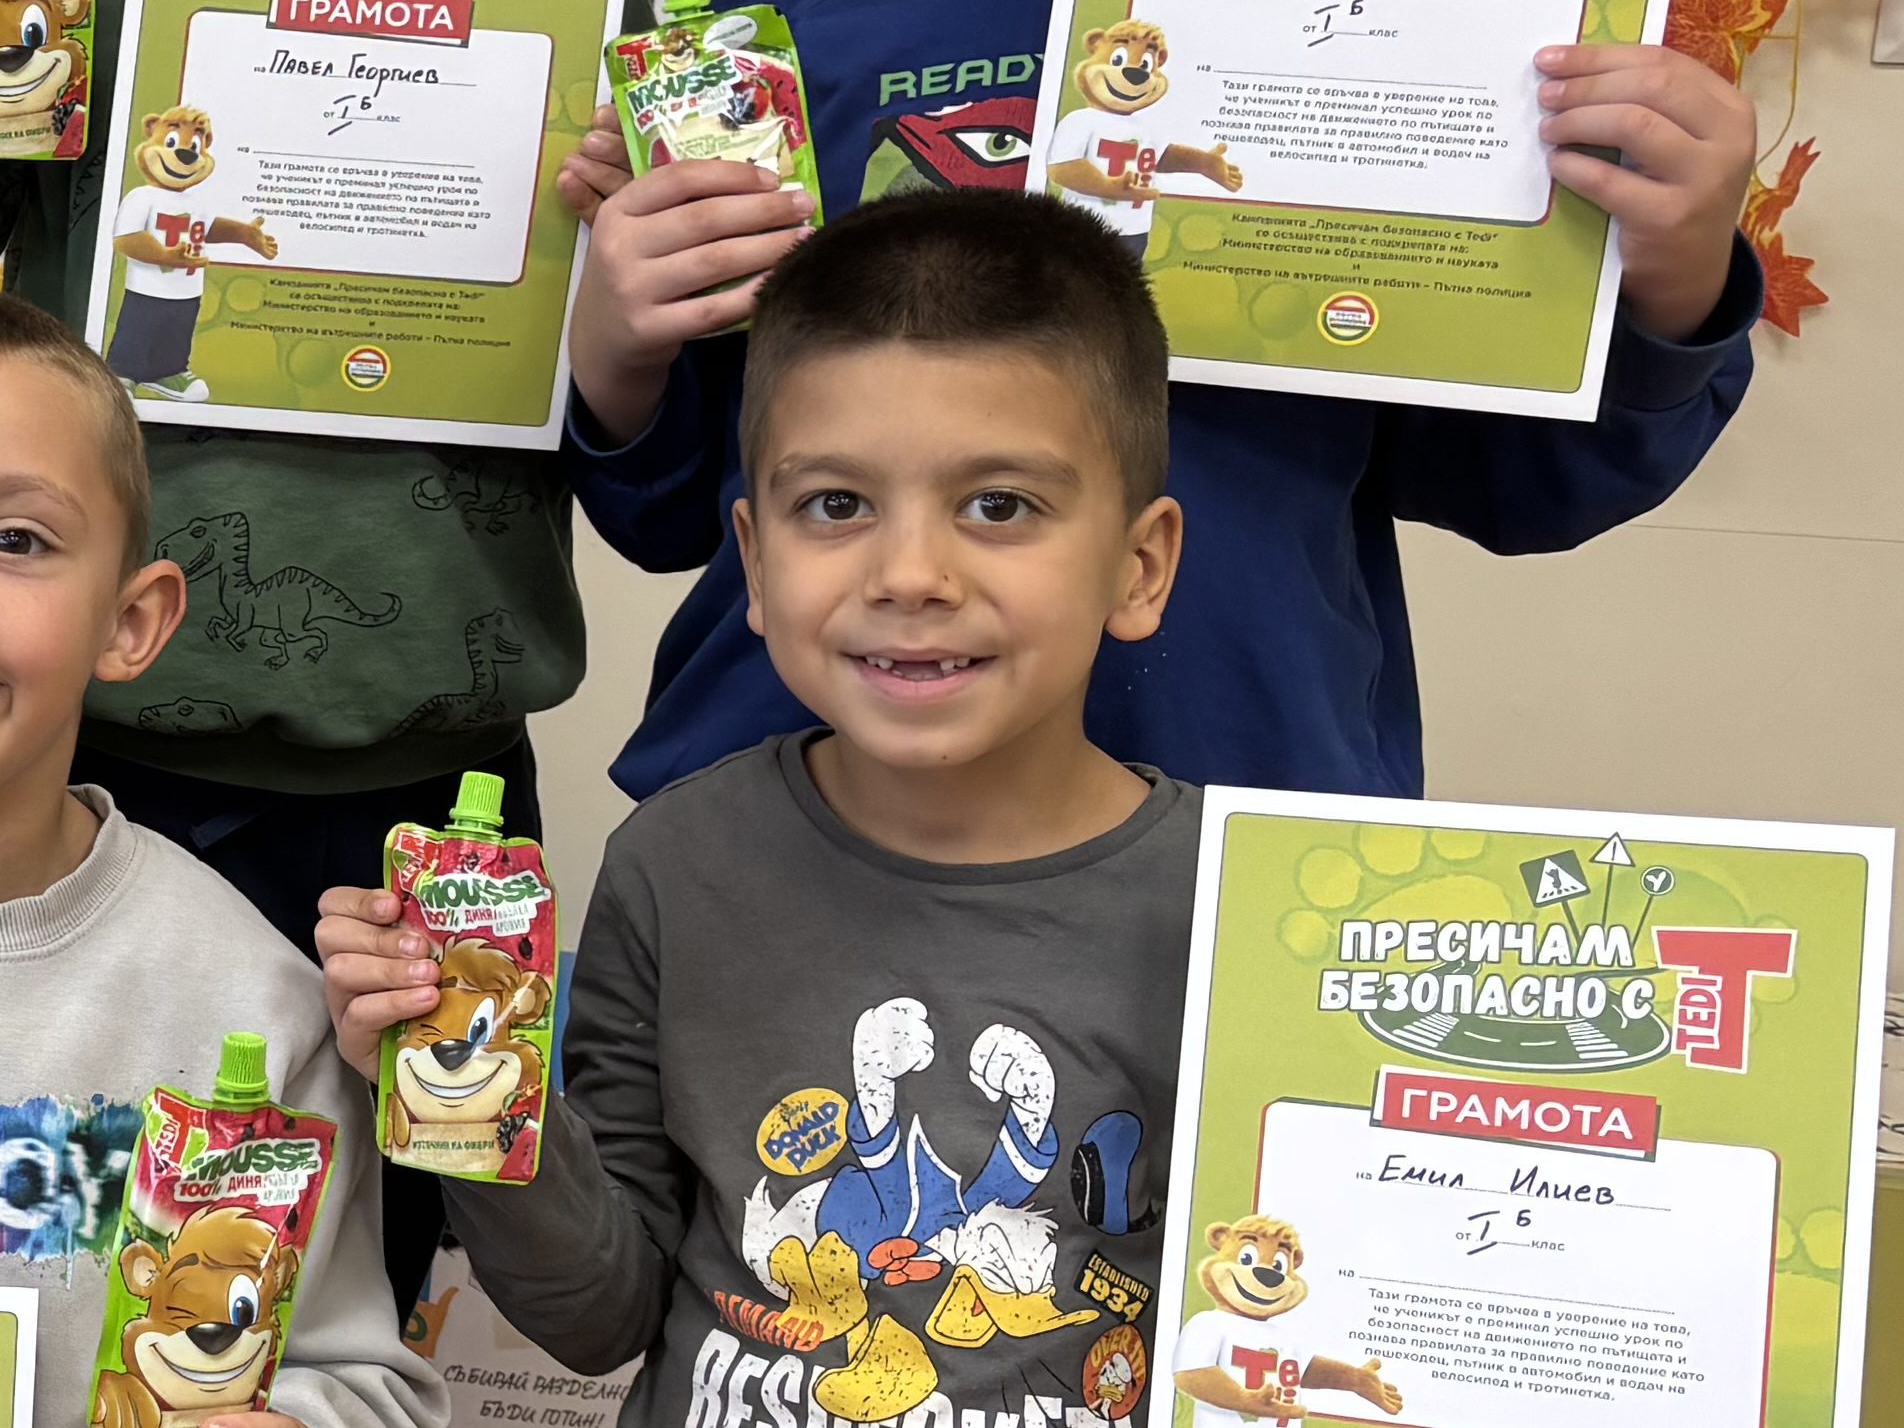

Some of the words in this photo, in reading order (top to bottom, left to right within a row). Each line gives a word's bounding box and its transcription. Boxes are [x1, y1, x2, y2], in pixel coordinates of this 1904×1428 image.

[269, 50, 334, 78] Павел
[349, 53, 439, 97] Георгиев
[880, 53, 1045, 107] READ
[420, 875, 550, 909] MOUSSE
[1340, 921, 1633, 966] ПРЕСИЧАМ
[1319, 969, 1607, 1019] БЕЗОПАСНО
[1622, 979, 1655, 1019] С
[1676, 977, 1718, 1051] TEDI
[764, 1102, 840, 1160] DONALD
[1401, 1088, 1632, 1139] ГРАМОТА
[187, 1141, 319, 1181] MOUSSE
[786, 1125, 841, 1172] DUCK
[180, 1179, 223, 1199] 100%
[1379, 1153, 1465, 1188] Емил
[1510, 1164, 1616, 1204] Илиев
[1080, 1269, 1143, 1322] 1934
[1088, 1254, 1151, 1302] ESTABLISHED
[1368, 1287, 1399, 1300] Тази
[1404, 1293, 1461, 1307] грамота
[1487, 1303, 1538, 1316] връчва
[1556, 1312, 1626, 1327] уверение
[1653, 1323, 1690, 1336] това,
[1394, 1307, 1460, 1321] ученикът
[1477, 1317, 1549, 1332] преминал
[1554, 1326, 1619, 1341] успешно
[1624, 1334, 1659, 1346] урок
[1348, 1330, 1406, 1344] познава
[1410, 1338, 1485, 1354] правилата
[1510, 1350, 1581, 1366] правилно
[1587, 1359, 1666, 1377] поведение
[1671, 1370, 1704, 1381] като
[1367, 1316, 1459, 1336] безопасност
[1484, 1332, 1574, 1350] движението
[1602, 1346, 1672, 1362] пътищата
[1364, 1347, 1448, 1366] пешеходец,
[1453, 1358, 1503, 1371] пътник
[1521, 1366, 1601, 1383] автомобил
[1619, 1379, 1663, 1391] водач
[1431, 1370, 1509, 1388] велосипед
[1528, 1382, 1614, 1400] тротинетка.
[480, 1400, 536, 1423] БЪДИ
